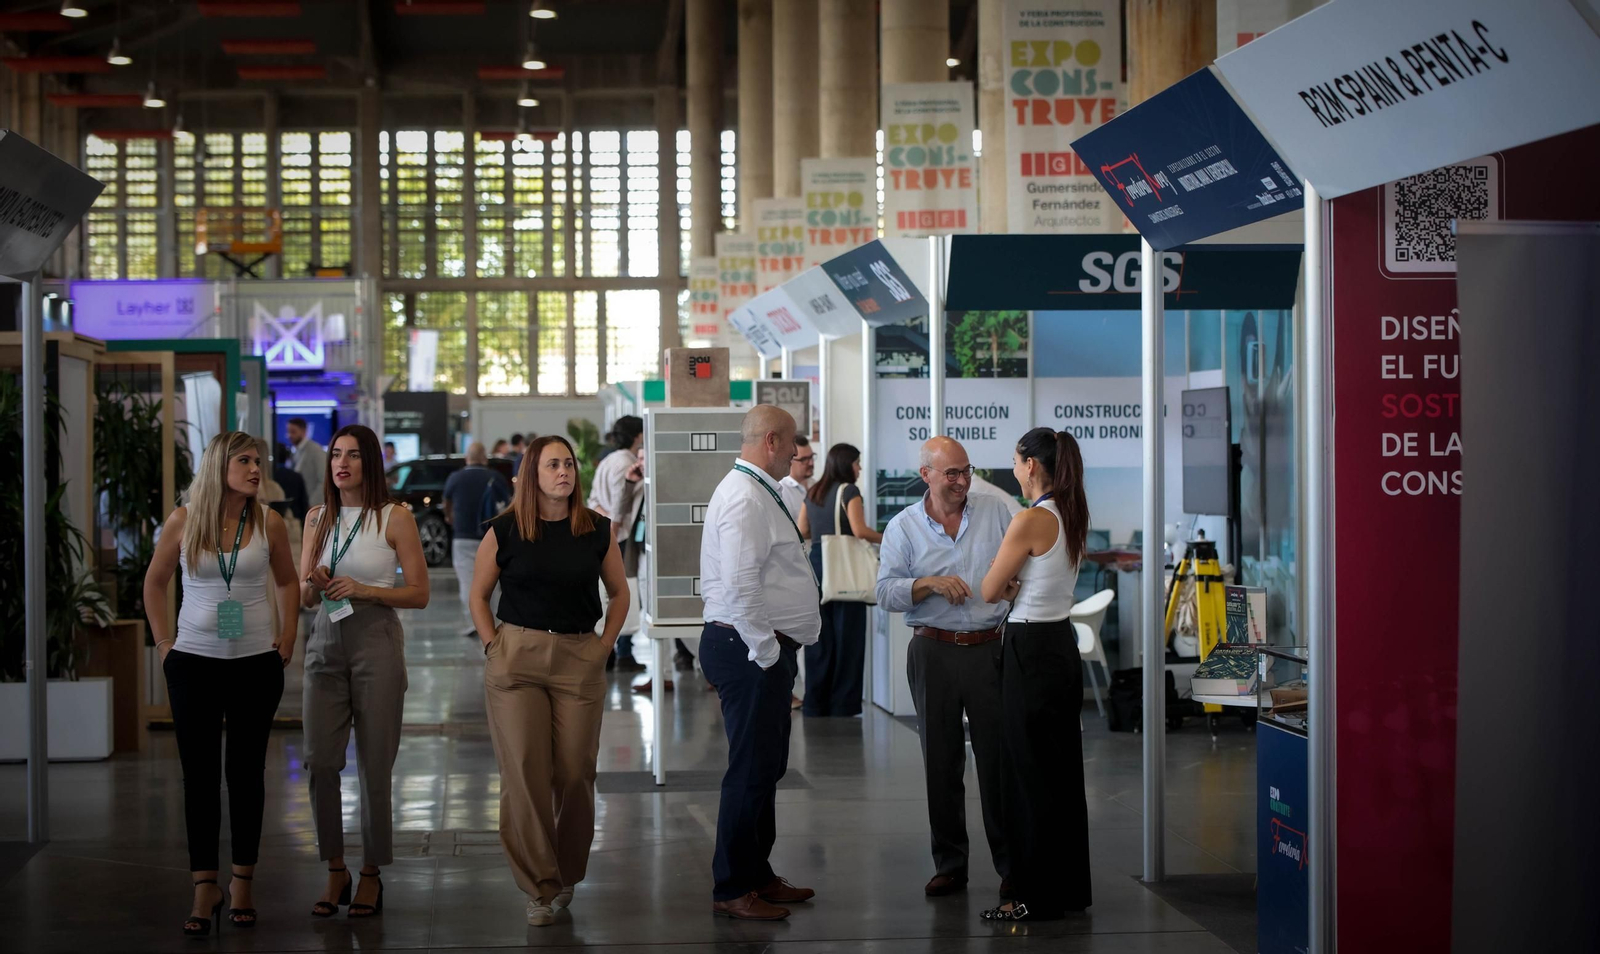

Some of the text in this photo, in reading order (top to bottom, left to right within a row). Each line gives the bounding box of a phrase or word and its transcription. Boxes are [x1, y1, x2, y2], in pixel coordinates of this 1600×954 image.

[1010, 39, 1102, 67] EXPO
[1010, 68, 1113, 97] CONS-
[1298, 20, 1510, 128] R2M SPAIN & PENTA-C
[1012, 98, 1117, 126] TRUYE
[888, 123, 959, 145] EXPO
[888, 146, 968, 167] CONS-
[889, 168, 971, 190] TRUYE
[806, 191, 864, 209] EXPO
[1033, 198, 1101, 210] Fernández
[807, 210, 872, 226] CONS-
[808, 227, 874, 245] TRUYE
[1078, 251, 1183, 293] SGS
[116, 300, 170, 317] Layher
[1381, 354, 1462, 379] EL FU
[896, 402, 1009, 420] CONRUCCIÓN
[1054, 404, 1167, 419] CONSTRUCC
[1381, 393, 1460, 418] SOST
[909, 426, 998, 441] SOENIBLE
[1099, 425, 1143, 440] DRON
[1381, 432, 1463, 457] DE LA
[1381, 471, 1463, 496] CONS
